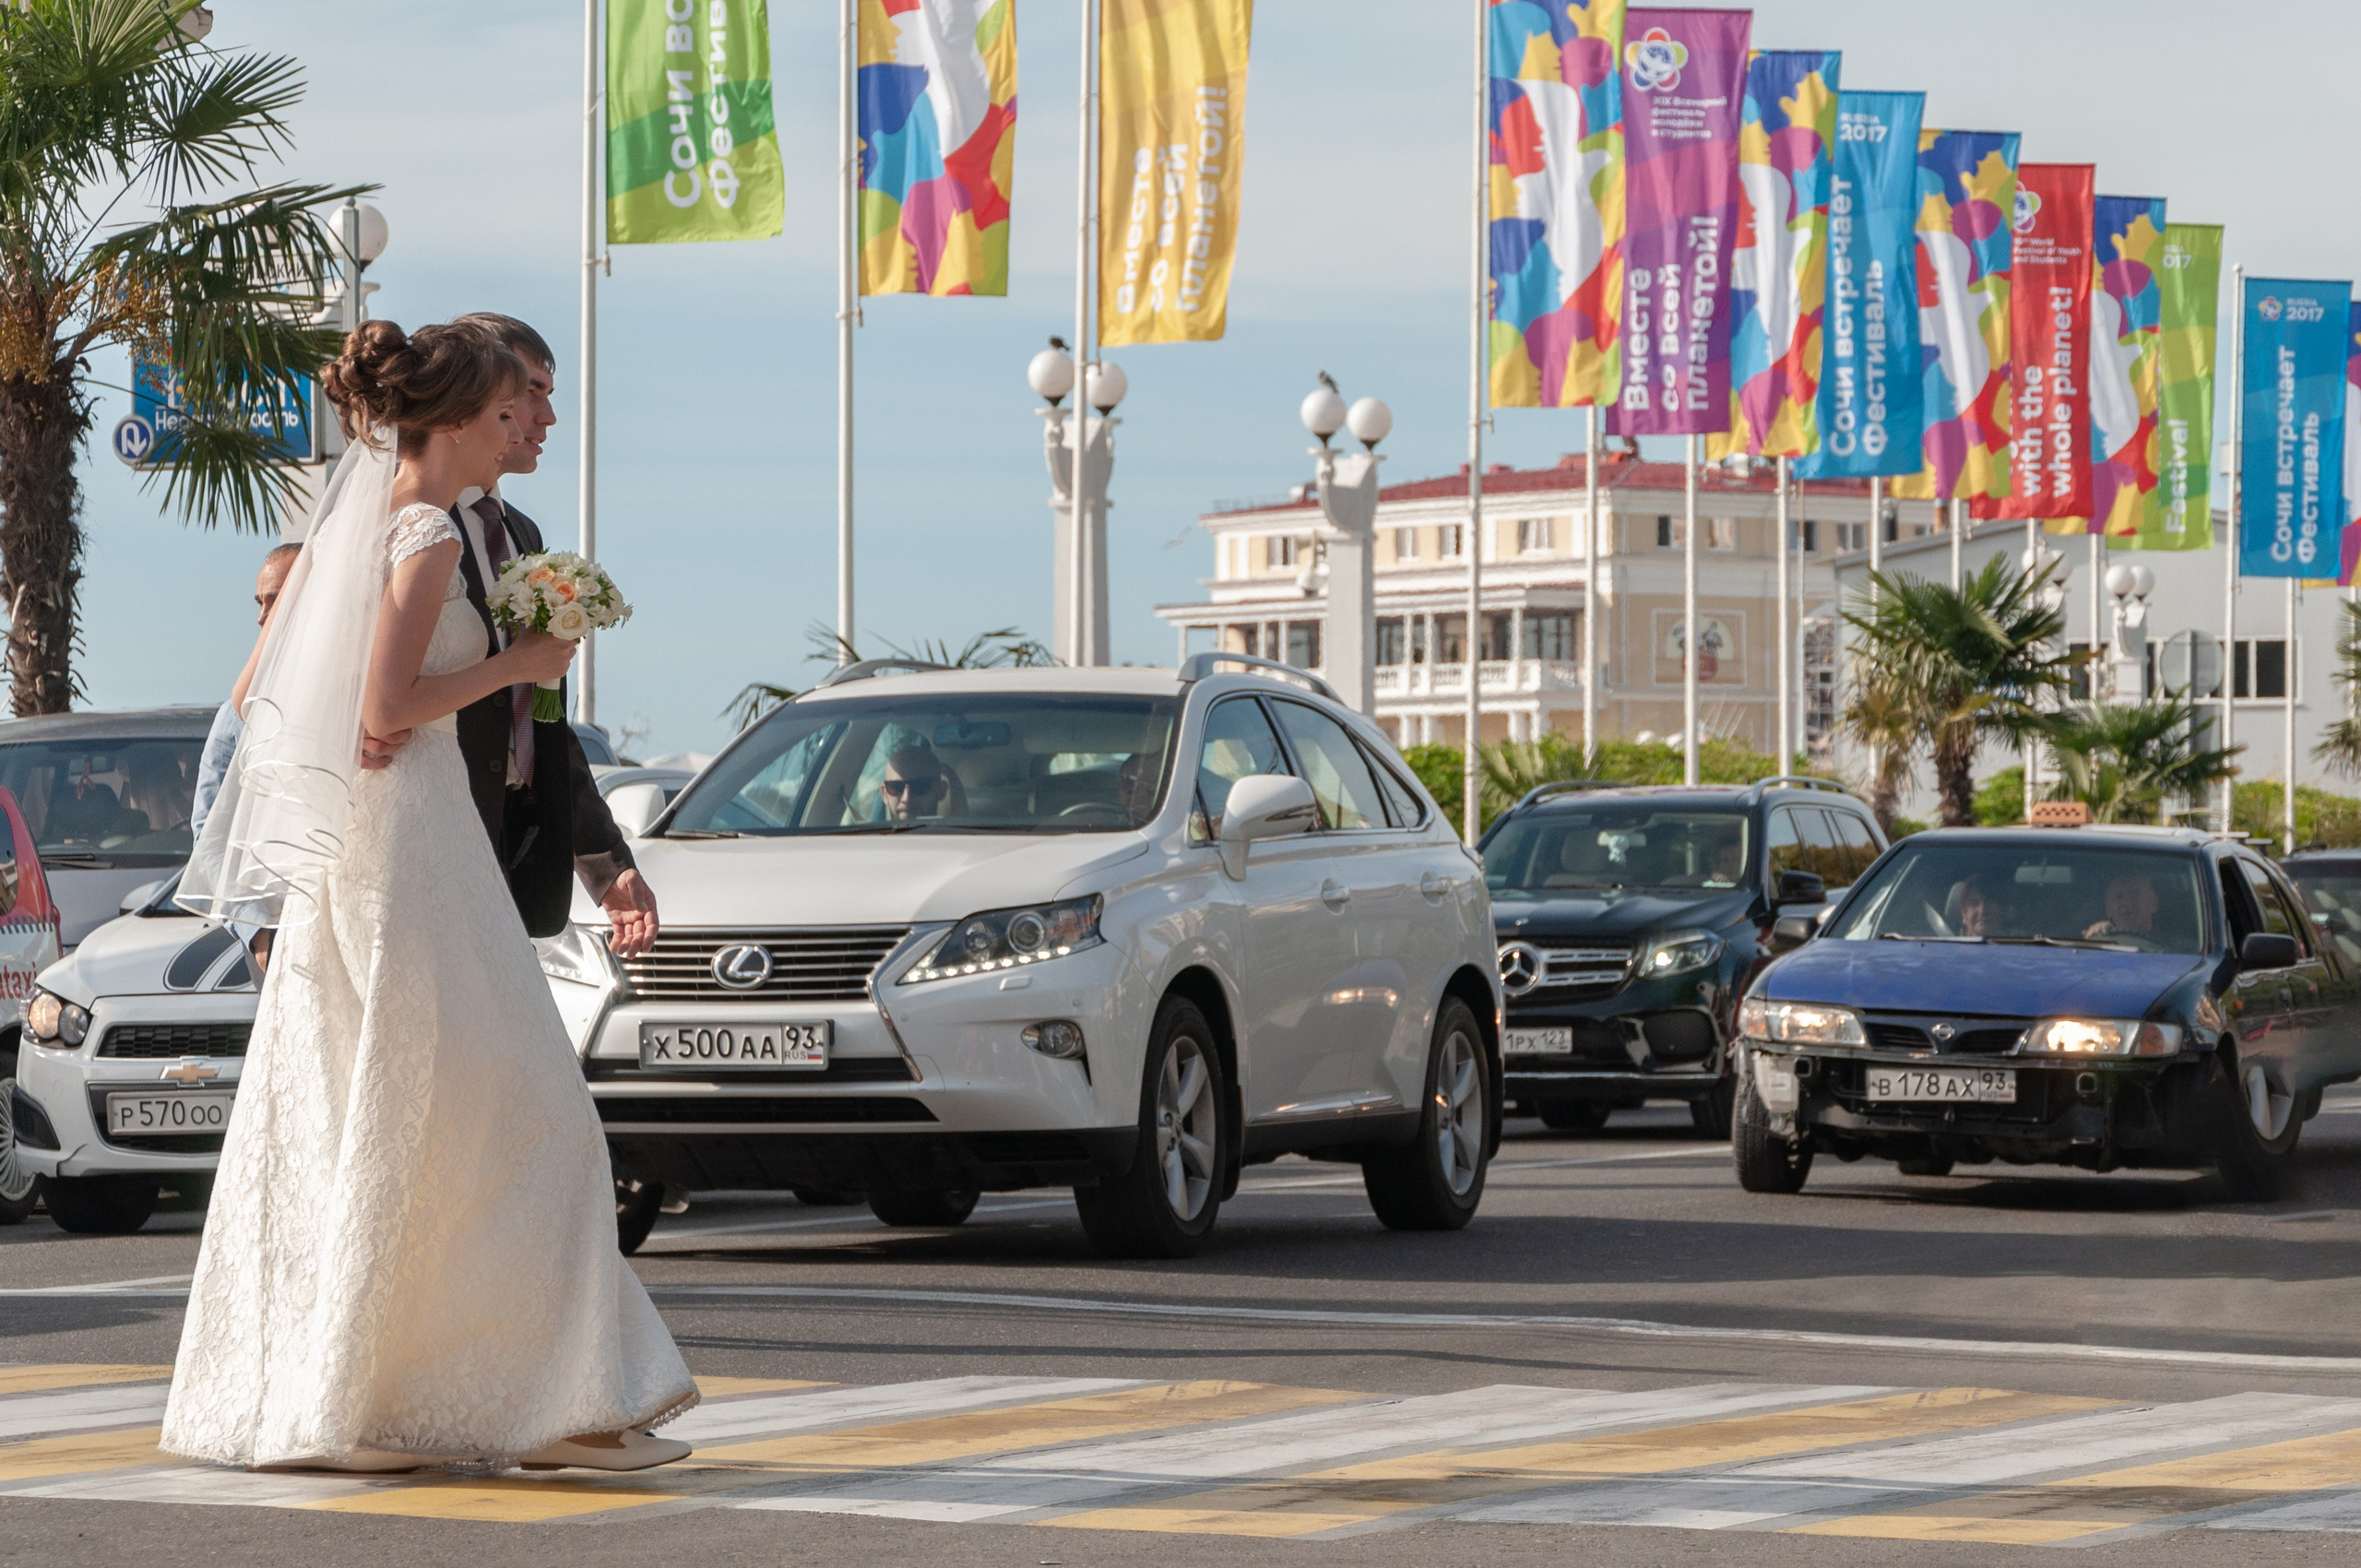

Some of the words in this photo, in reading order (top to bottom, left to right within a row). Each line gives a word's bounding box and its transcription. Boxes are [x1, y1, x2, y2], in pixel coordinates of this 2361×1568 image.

[664, 70, 702, 208] Сочи
[708, 0, 741, 208] Фестив
[1840, 124, 1888, 142] 2017
[1117, 147, 1152, 314] Вместе
[1157, 144, 1189, 247] всей
[1175, 86, 1228, 311] планетой!
[1657, 264, 1681, 355] всей
[1832, 174, 1859, 358] встречает
[2163, 254, 2192, 269] 017
[1623, 267, 1652, 410] Вместе
[1687, 216, 1718, 410] планетой!
[1862, 259, 1888, 457] Фестиваль
[2047, 286, 2078, 396] planet!
[2287, 307, 2324, 322] 2017
[1661, 363, 1680, 412] со
[1828, 366, 1857, 457] Сочи
[2018, 364, 2044, 421] the
[2276, 345, 2299, 486] встречает
[2018, 427, 2044, 498] with
[2047, 402, 2073, 498] whole
[2165, 419, 2189, 532] Festival
[2296, 411, 2320, 564] Фестиваль
[2271, 492, 2294, 563] Сочи
[784, 1051, 807, 1060] RUS
[786, 1026, 815, 1050] 93
[1506, 1033, 1536, 1050] 1РХ
[1983, 1073, 2006, 1090] 93
